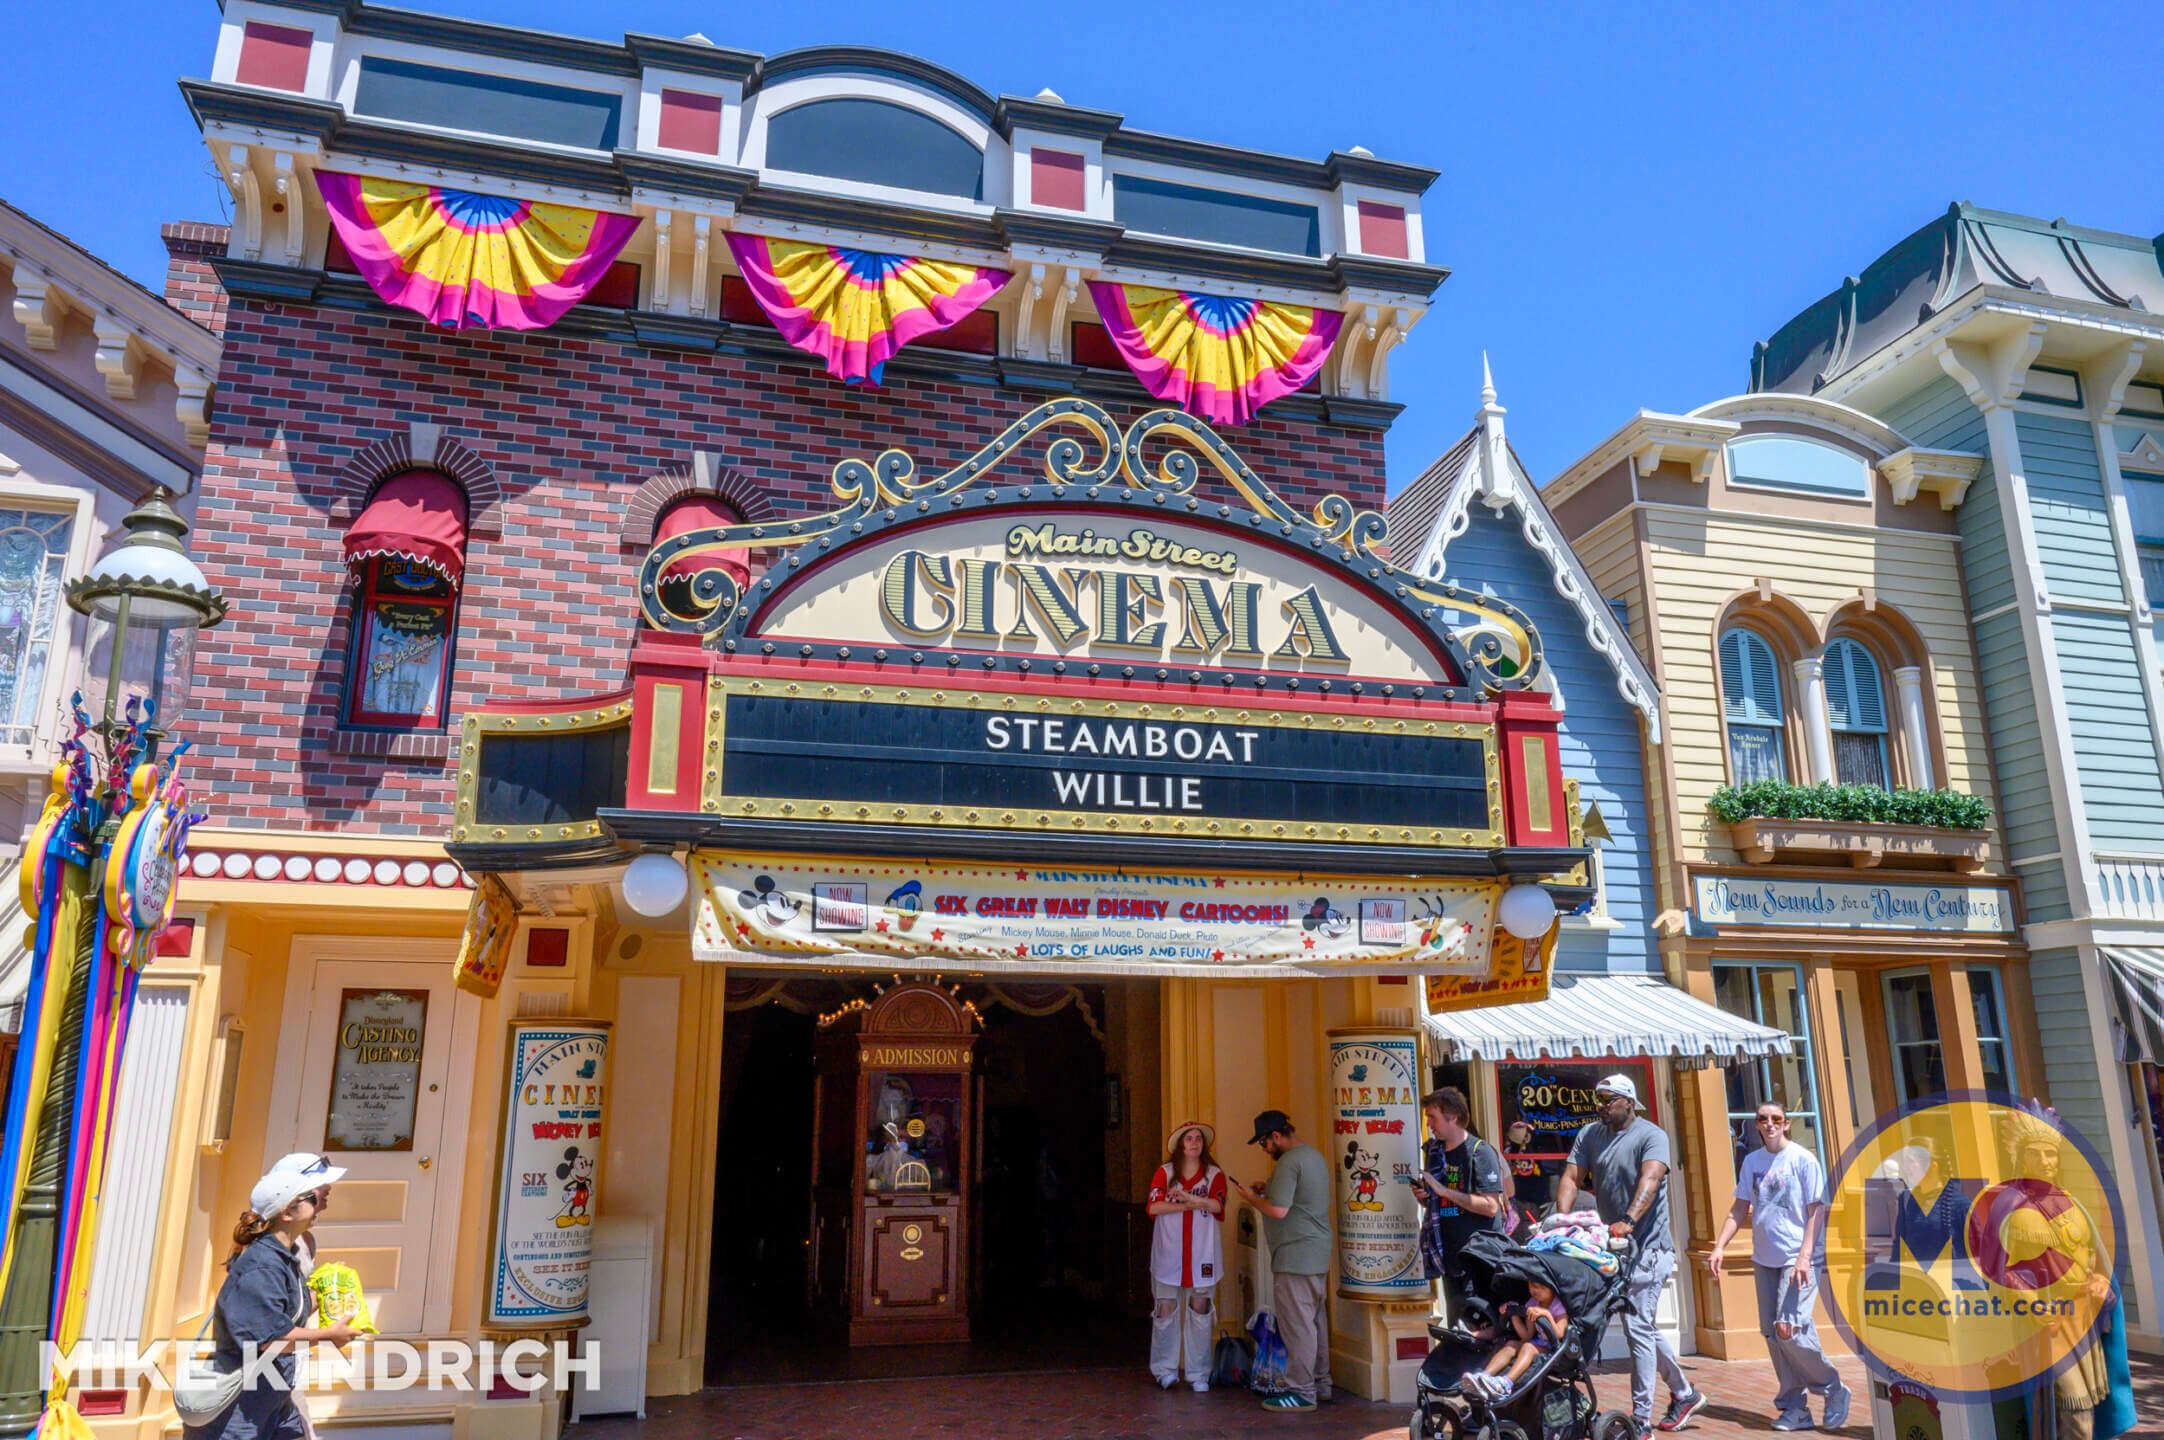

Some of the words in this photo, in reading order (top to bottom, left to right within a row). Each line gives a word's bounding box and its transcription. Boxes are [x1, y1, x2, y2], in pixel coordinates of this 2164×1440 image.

[1005, 523, 1118, 556] Main
[1124, 529, 1237, 575] Street
[879, 549, 1351, 668] CINEMA
[985, 716, 1259, 763] STEAMBOAT
[1051, 771, 1204, 810] WILLIE
[829, 887, 852, 902] NOW
[935, 896, 968, 917] SIX
[976, 897, 1038, 919] GREAT
[1043, 898, 1091, 919] WALT
[1097, 898, 1169, 921] DISNEY
[1179, 901, 1289, 925] CARTOONS!
[1373, 902, 1393, 919] NOW
[1706, 881, 1761, 916] New
[1762, 882, 1837, 918] Sounds
[1841, 894, 1859, 912] for
[1860, 899, 1871, 909] a
[1871, 888, 1921, 920] New
[1923, 889, 2007, 929] Century
[819, 907, 864, 926] SHOWING
[1001, 926, 1032, 939] Mickey
[1070, 927, 1099, 938] Minnie
[1136, 928, 1167, 940] Donald
[1196, 931, 1219, 942] Pluto
[1364, 922, 1403, 940] SHOWING
[1031, 943, 1064, 956] LOTS
[1071, 944, 1088, 956] OF
[1094, 944, 1144, 956] LAUGHS
[1149, 946, 1177, 958] AND
[1180, 947, 1212, 960] FUN!
[363, 1015, 404, 1026] Disneyland
[342, 1023, 418, 1050] CASTING
[873, 1048, 959, 1065] ADMISSION
[1572, 1104, 1593, 1113] MUSIC
[532, 1121, 583, 1140] MICKEY
[1365, 1119, 1405, 1135] MOUSE
[1393, 1163, 1412, 1175] SIX
[522, 1172, 548, 1185] SIX
